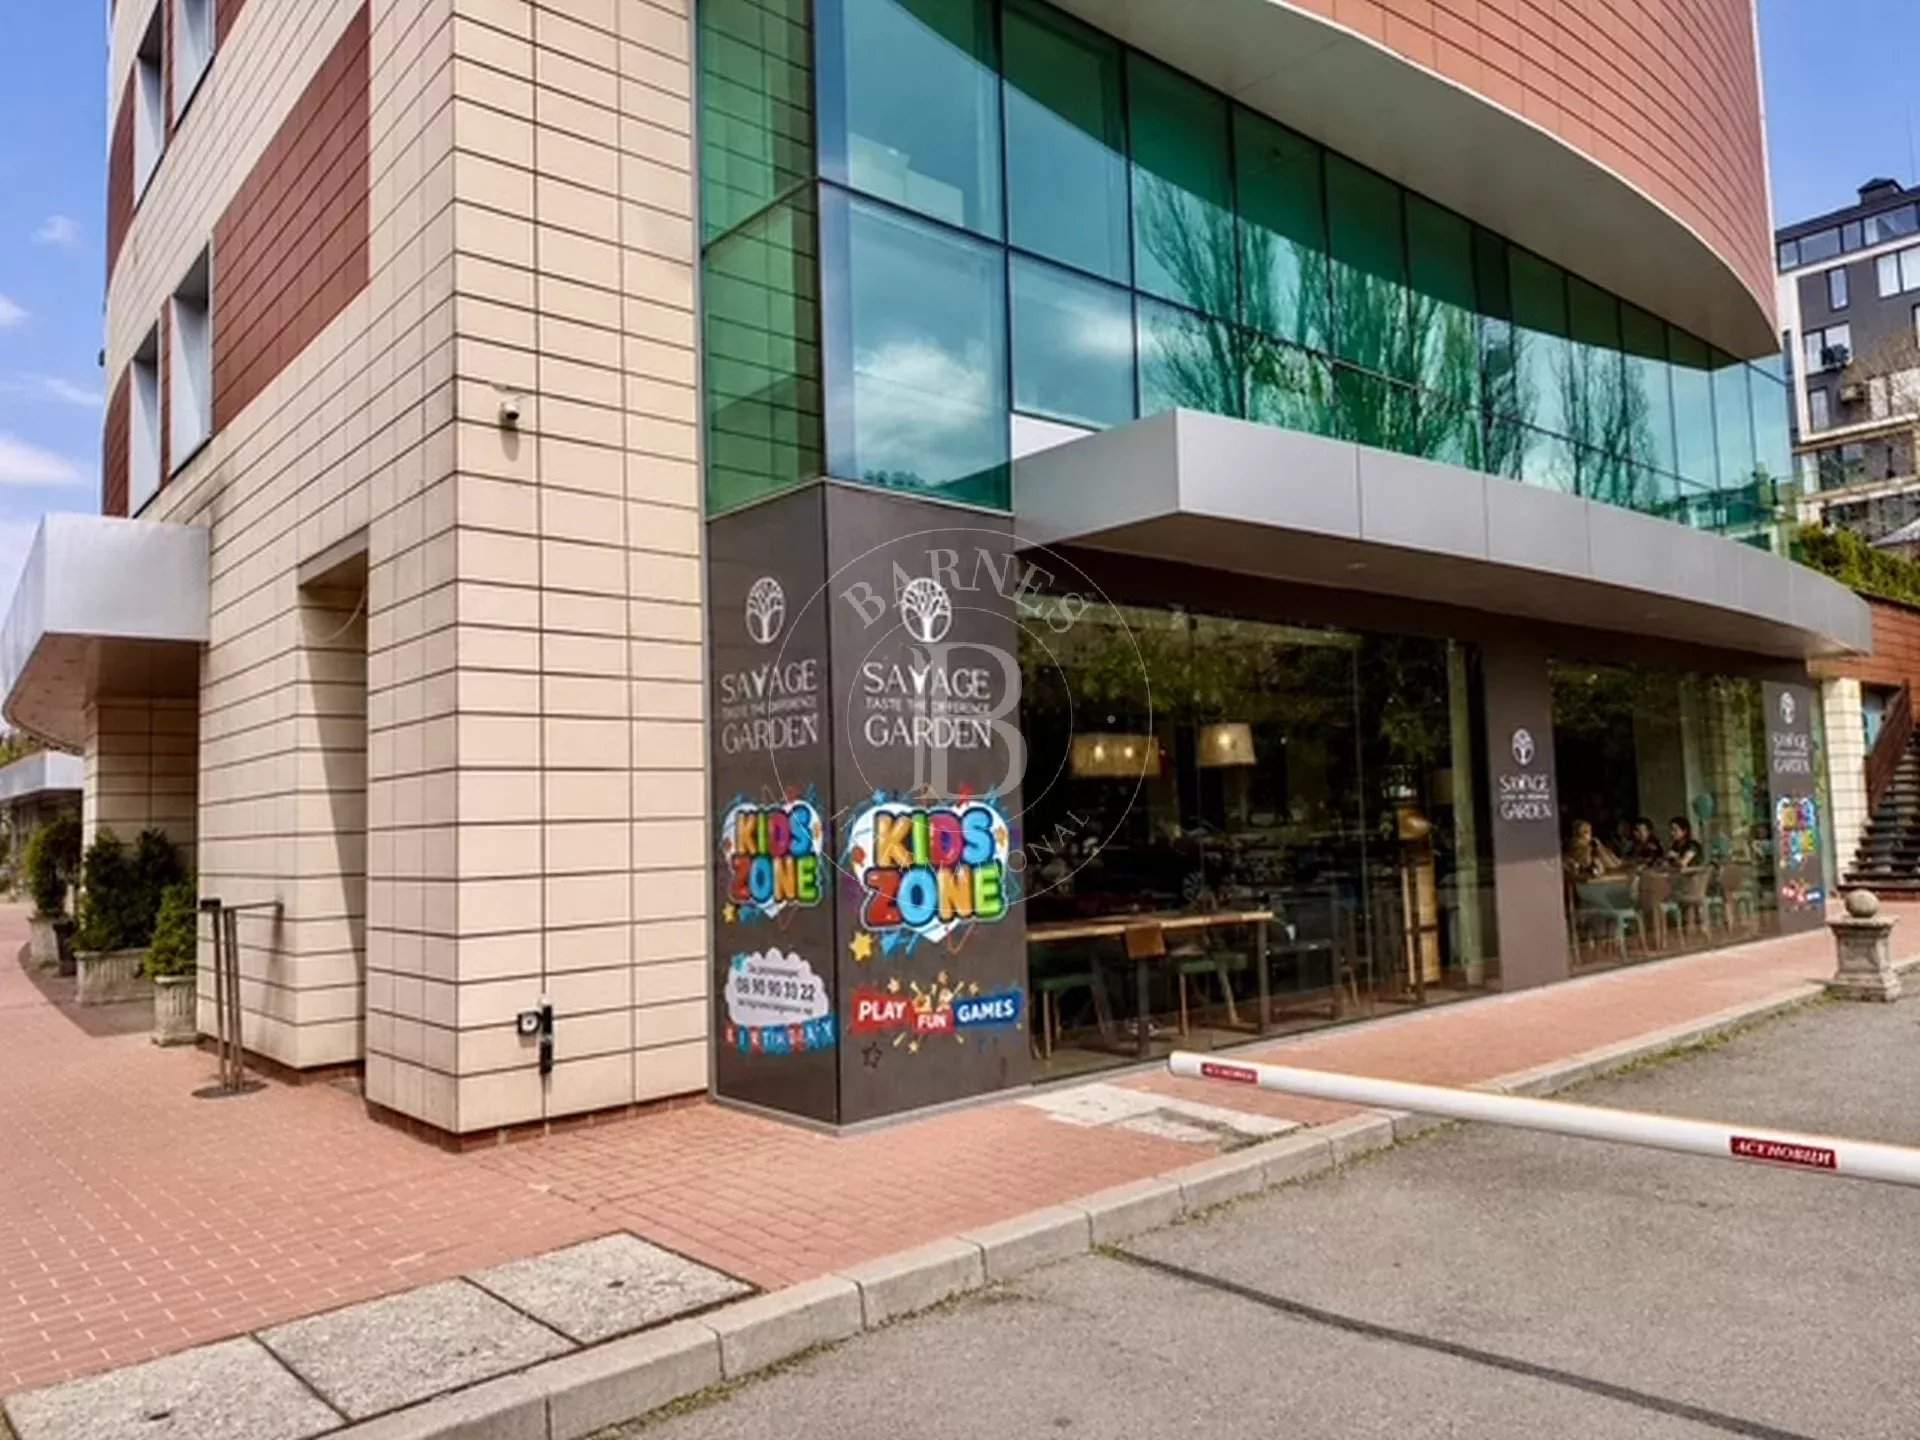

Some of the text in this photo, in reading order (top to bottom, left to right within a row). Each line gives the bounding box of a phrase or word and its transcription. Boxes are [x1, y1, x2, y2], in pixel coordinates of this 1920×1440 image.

[720, 659, 817, 703] SAVAGE
[863, 662, 992, 699] SAVAGE
[722, 712, 818, 754] GARDEN
[864, 714, 992, 749] GARDEN
[735, 804, 812, 858] KIDS
[873, 806, 995, 867] KIDS
[729, 856, 820, 903] ZONE
[865, 861, 1003, 927] ZONE
[800, 983, 816, 1001] 22
[858, 1001, 907, 1022] PLAY
[957, 999, 1014, 1022] GAMES
[917, 1013, 947, 1029] FUN
